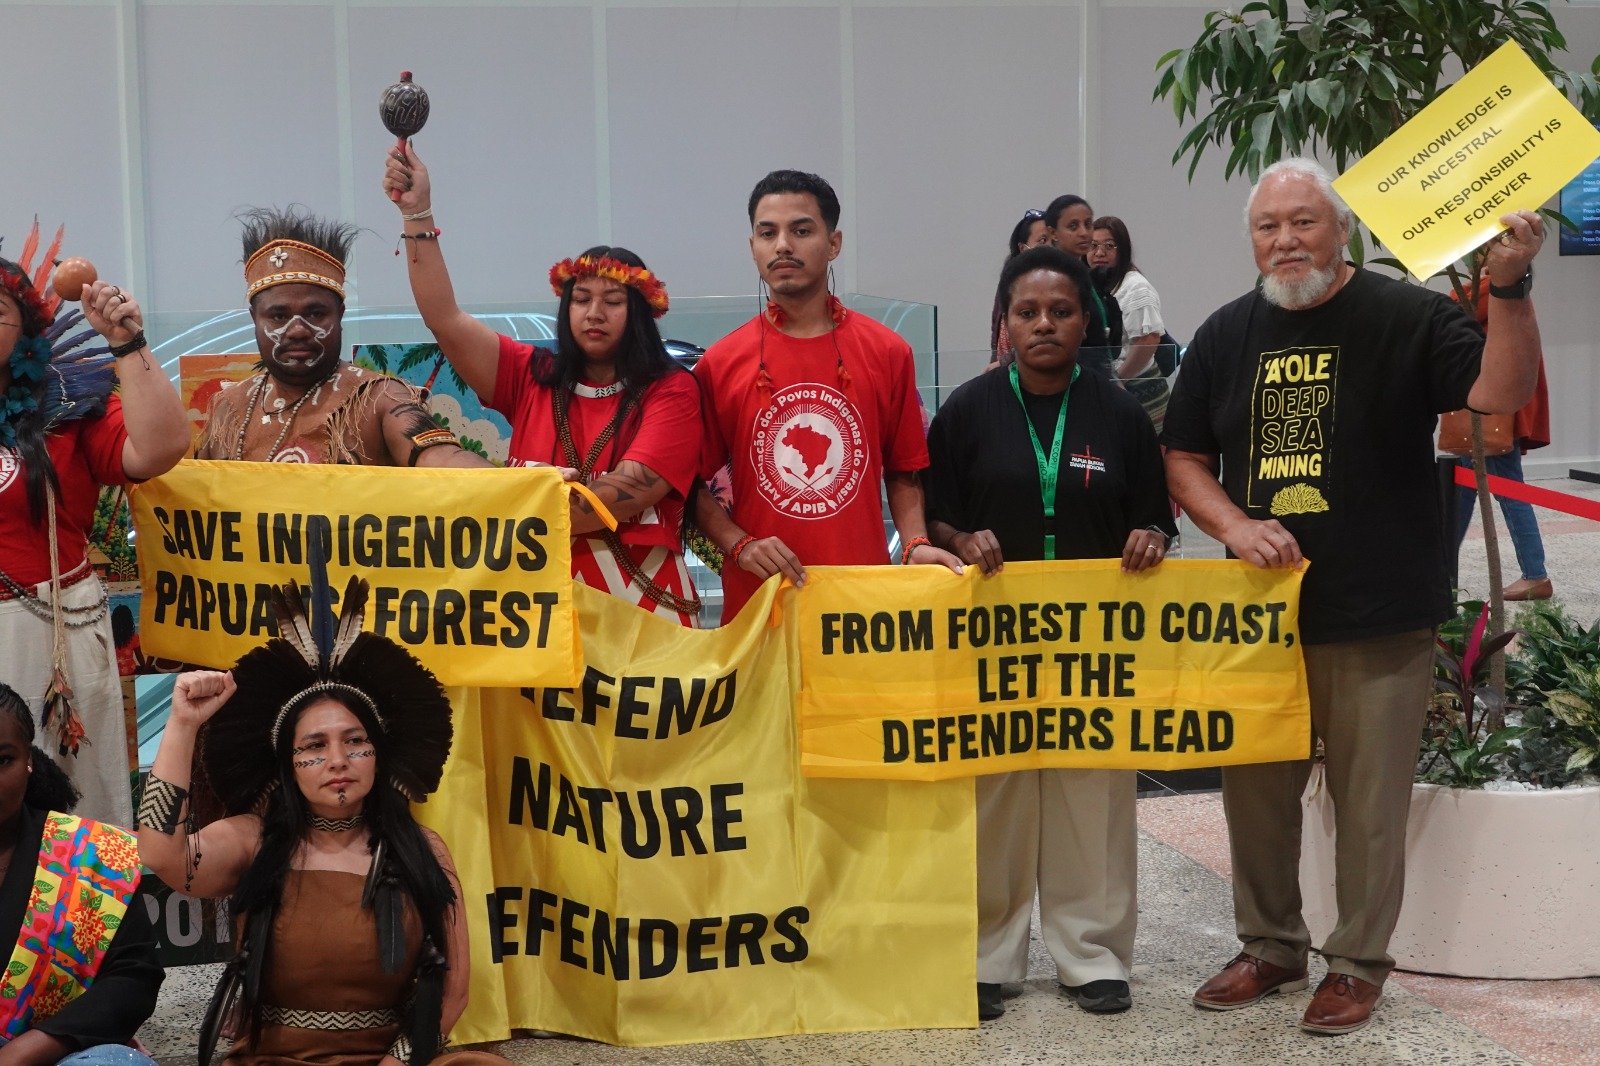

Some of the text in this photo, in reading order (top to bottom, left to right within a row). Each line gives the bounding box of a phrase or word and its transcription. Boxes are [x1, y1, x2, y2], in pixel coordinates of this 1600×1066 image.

[1377, 84, 1513, 194] OUR KNOWLEDGE IS
[1419, 126, 1503, 192] ANCESTRAL
[1402, 118, 1562, 241] OUR RESPONSIBILITY IS
[1463, 171, 1532, 226] FOREVER
[760, 404, 778, 428] dos
[776, 389, 817, 407] Povos
[819, 389, 862, 446] Indígenas
[853, 448, 864, 467] do
[1262, 385, 1330, 419] DEEP
[1261, 417, 1324, 454] SEA
[1258, 453, 1322, 480] MINING
[154, 507, 243, 562] SAVE
[790, 501, 827, 514] APIB
[373, 587, 559, 649] FOREST
[820, 600, 1295, 655] FROM FOREST TO COAST,
[520, 665, 738, 740] EFEND
[977, 653, 1136, 702] LET THE
[882, 707, 1234, 763] DEFENDERS LEAD
[508, 756, 747, 860] NATURE
